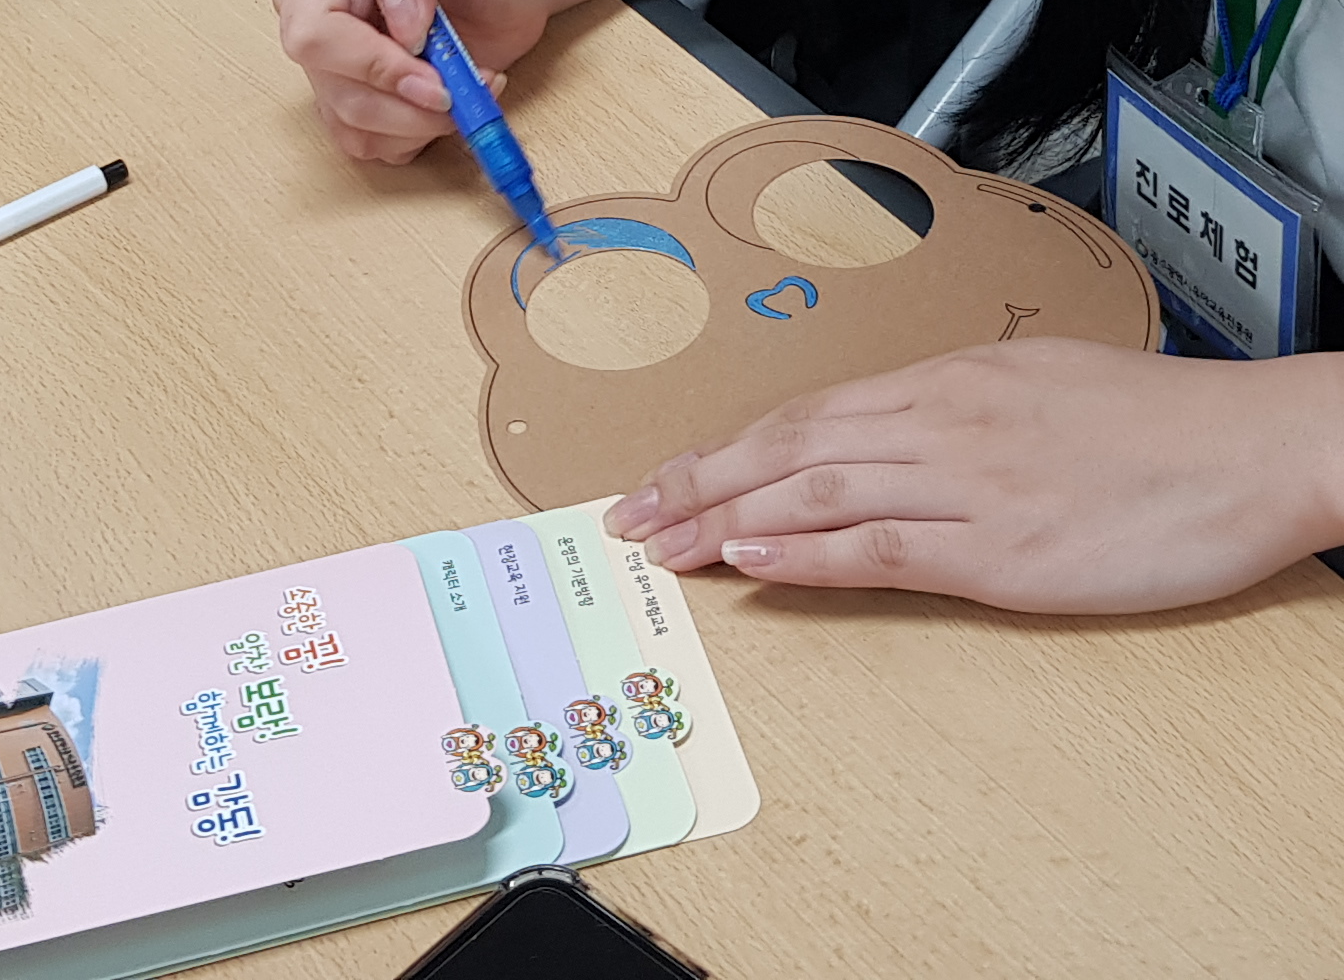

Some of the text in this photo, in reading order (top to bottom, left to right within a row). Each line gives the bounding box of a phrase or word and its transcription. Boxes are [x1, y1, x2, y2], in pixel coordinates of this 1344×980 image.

[1136, 158, 1258, 290] 진로체험
[441, 559, 468, 612] 캐릭터 소개
[498, 543, 531, 606] 현장교육 지원
[558, 536, 595, 608] 운영의 기본방향
[634, 574, 654, 594] 유아
[645, 595, 669, 637] 체험교육
[283, 587, 345, 671] 소중한 꿈!
[230, 632, 299, 740] 알찬 보람!
[185, 691, 262, 842] 함께하는 감동!
